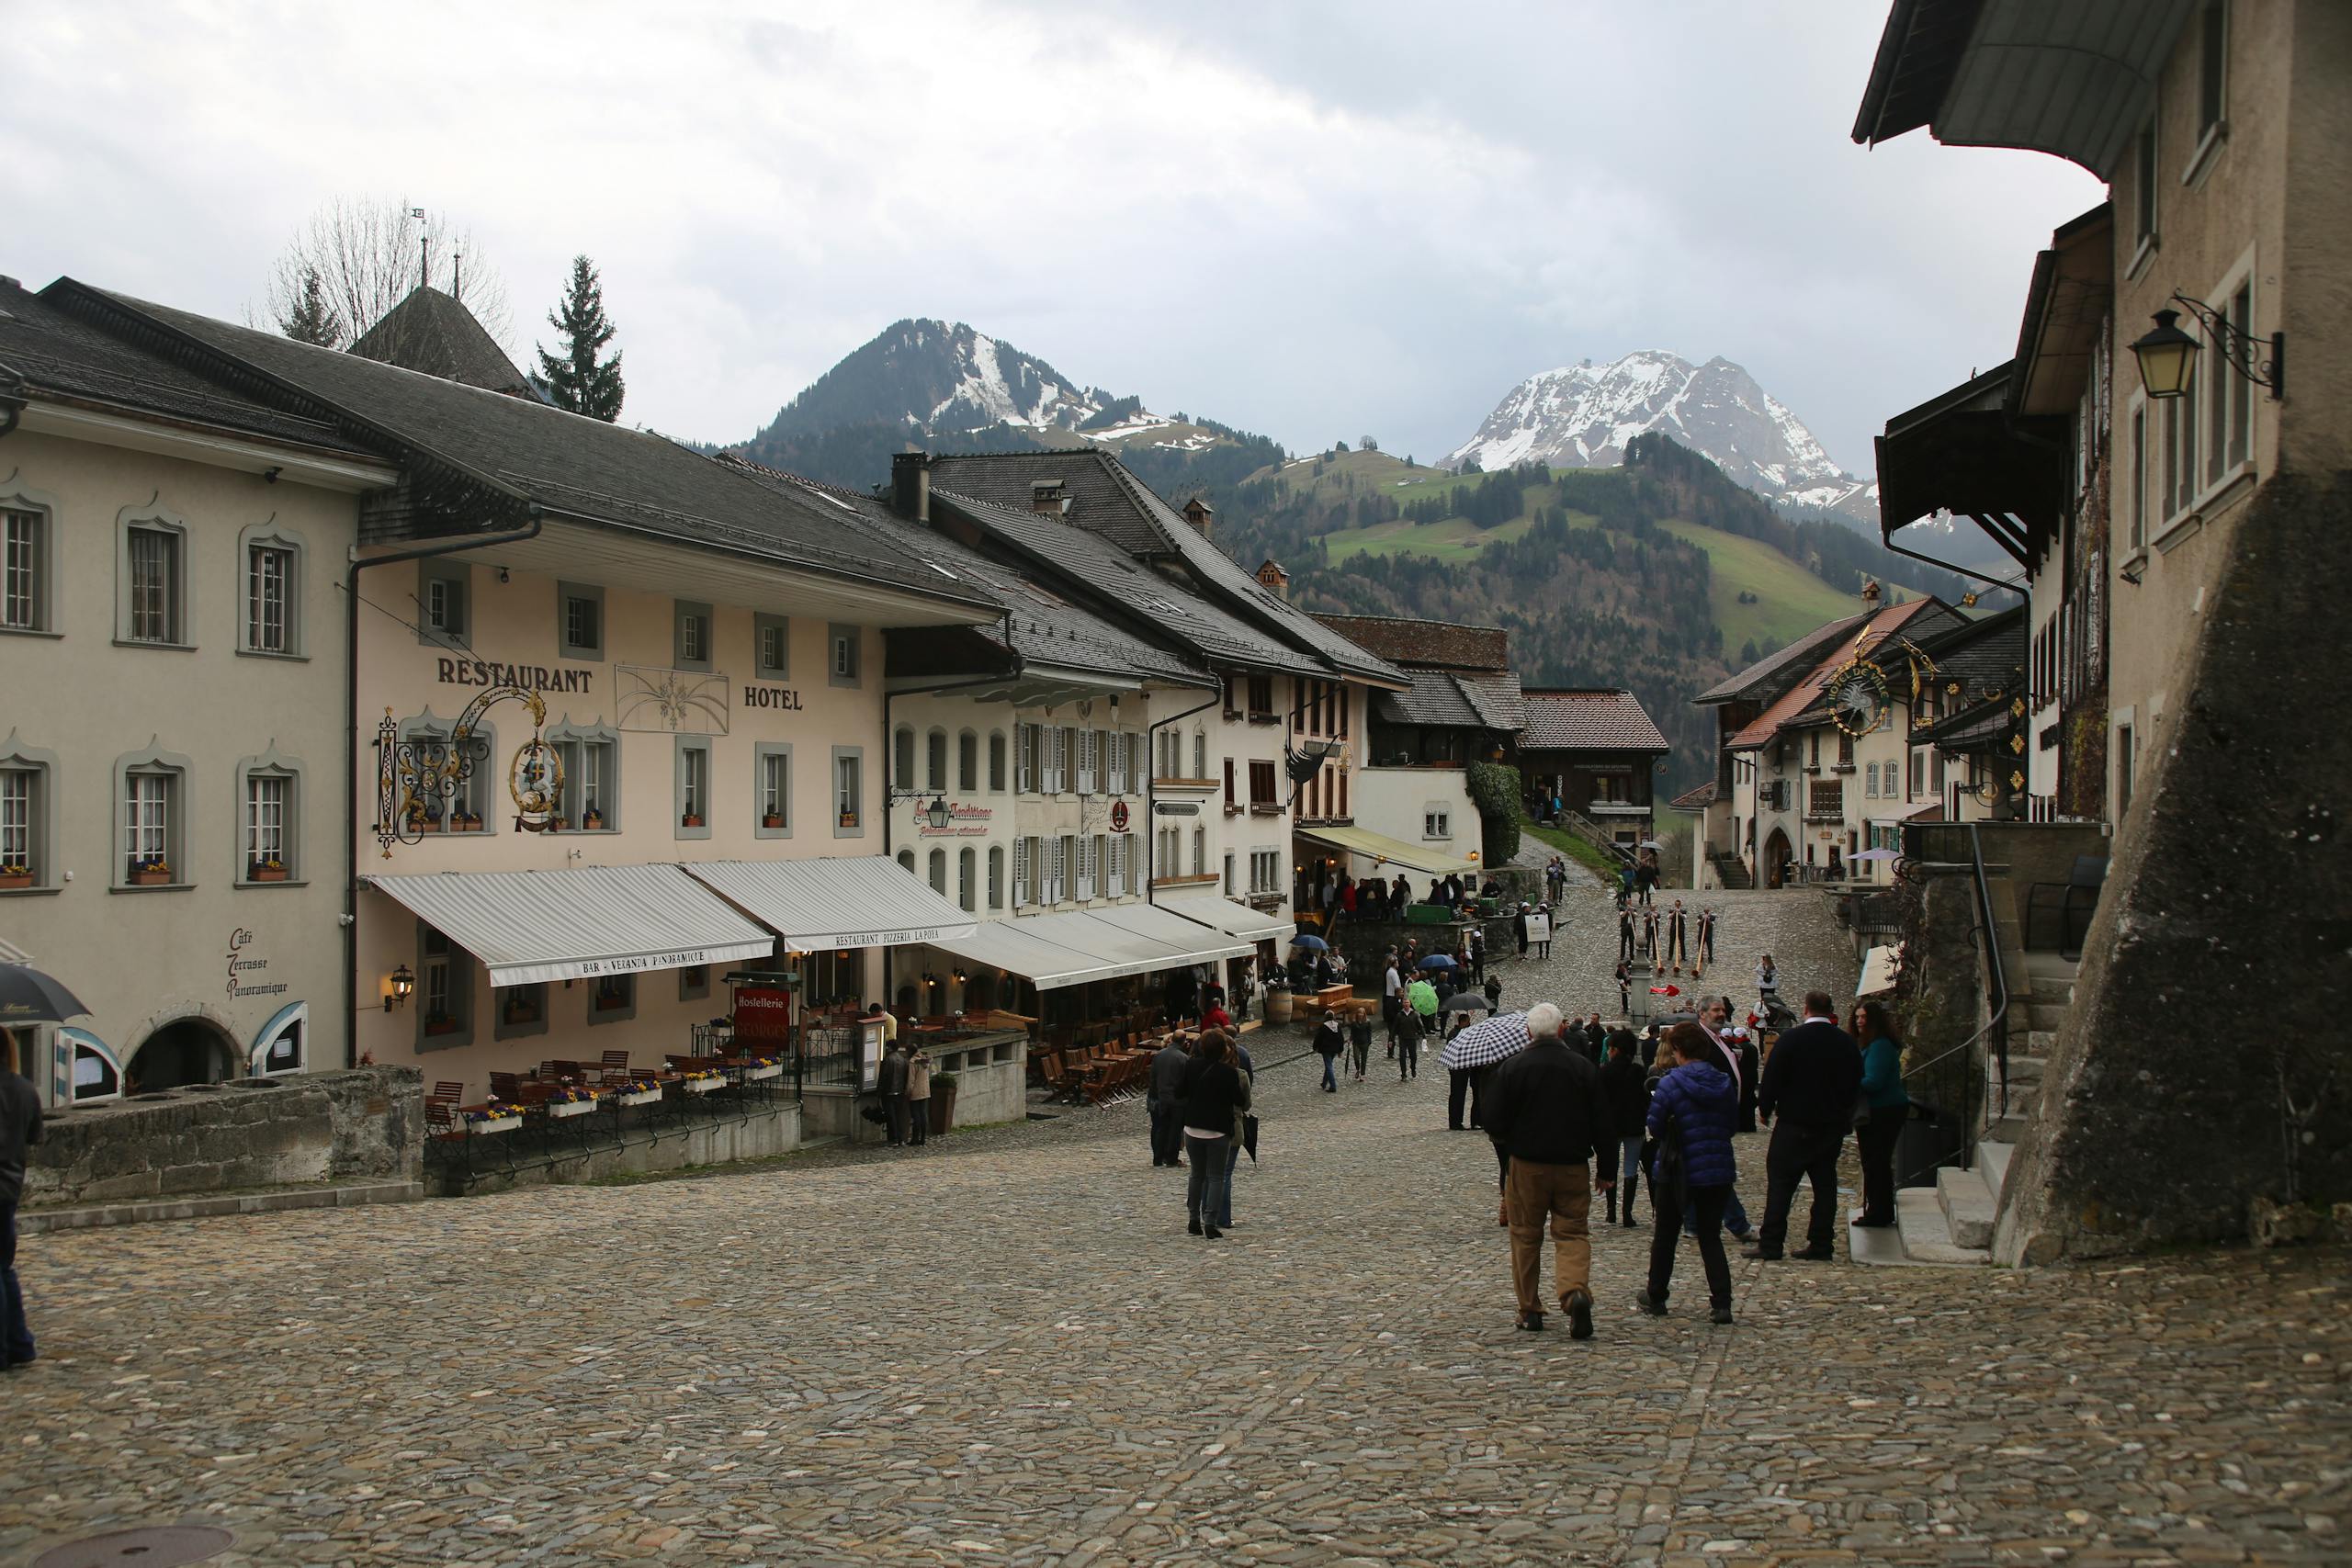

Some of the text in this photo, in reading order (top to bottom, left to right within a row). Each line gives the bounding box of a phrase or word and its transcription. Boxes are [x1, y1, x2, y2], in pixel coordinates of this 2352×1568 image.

[437, 658, 593, 694] RESTAURANT
[744, 686, 803, 711] HOTEL
[230, 927, 253, 951] Café
[836, 934, 879, 946] RESTAURANT
[883, 931, 910, 943] PIZZERIA
[226, 953, 268, 977] Terrasse
[582, 962, 600, 974] BAR
[611, 957, 647, 971] VERANDA
[653, 951, 705, 966] PANORAMIQUE
[226, 977, 288, 1001] Panoramique
[739, 995, 784, 1009] Hostellerie
